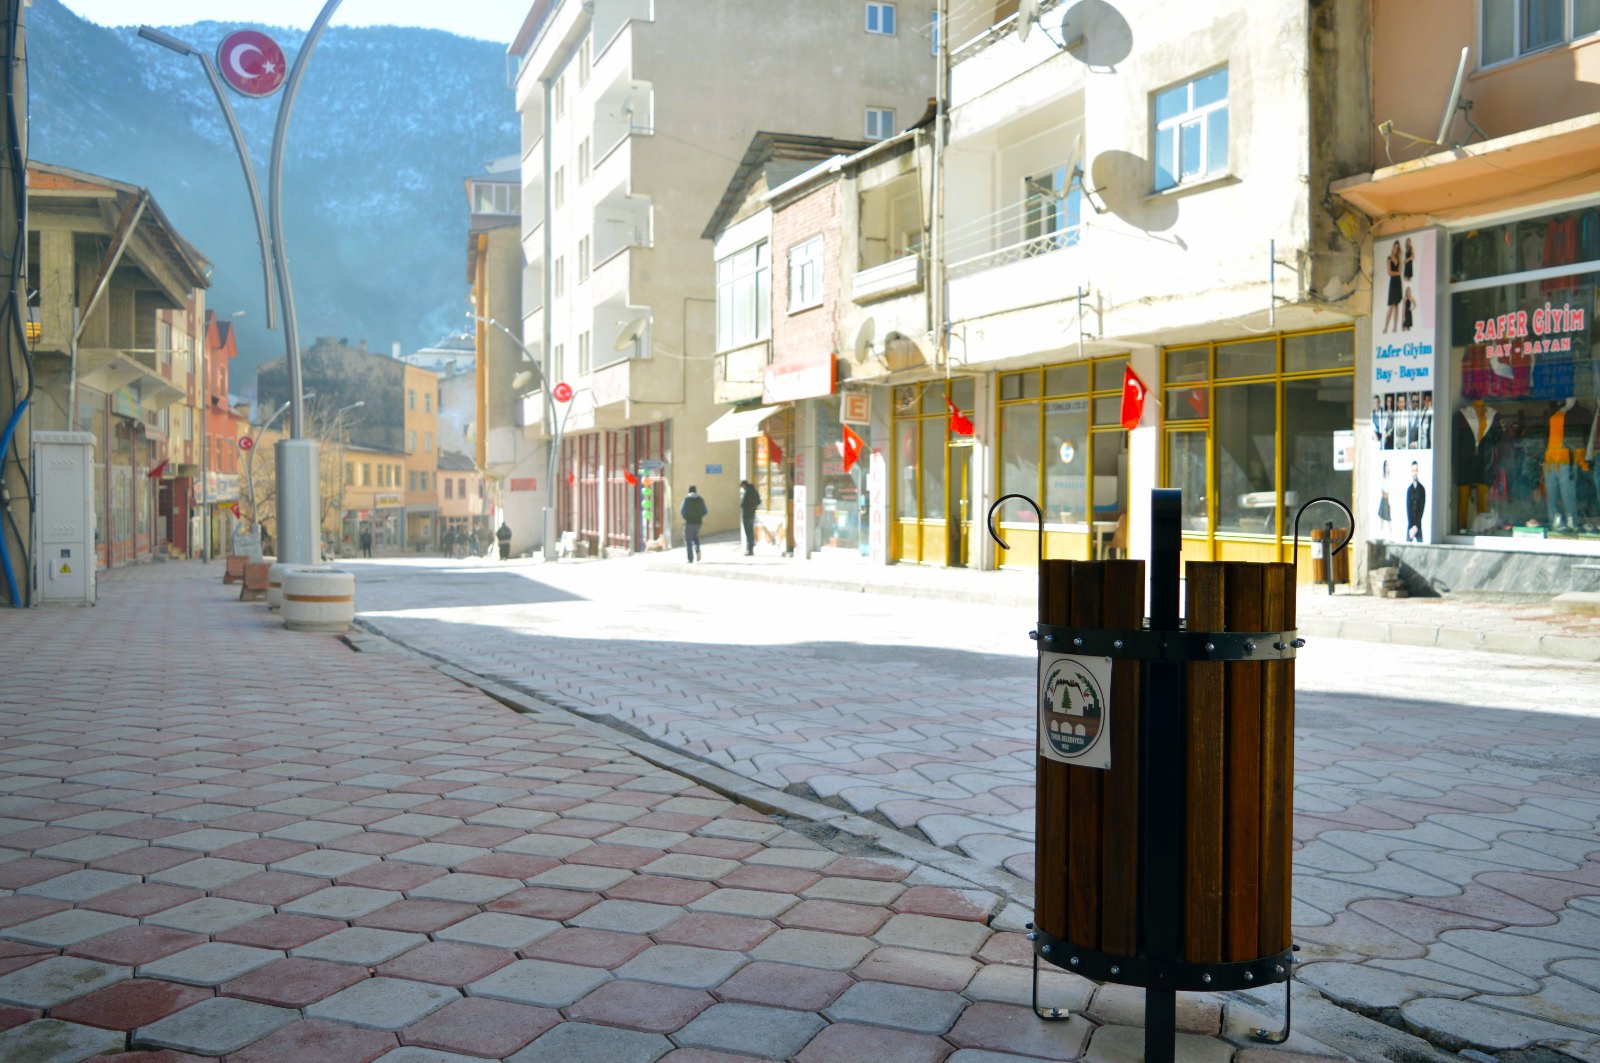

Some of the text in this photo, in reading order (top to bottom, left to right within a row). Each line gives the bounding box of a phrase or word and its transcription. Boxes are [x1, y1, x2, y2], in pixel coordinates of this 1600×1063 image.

[1475, 302, 1584, 341] ZAFER GİYİM
[1376, 341, 1432, 359] Zafer Giyim
[1486, 343, 1512, 358] BAY
[1524, 338, 1571, 354] BAYAN
[1376, 367, 1393, 383] Bay
[1399, 365, 1429, 381] Bayan
[850, 398, 865, 417] E
[1061, 735, 1084, 745] BELEDİYESİ
